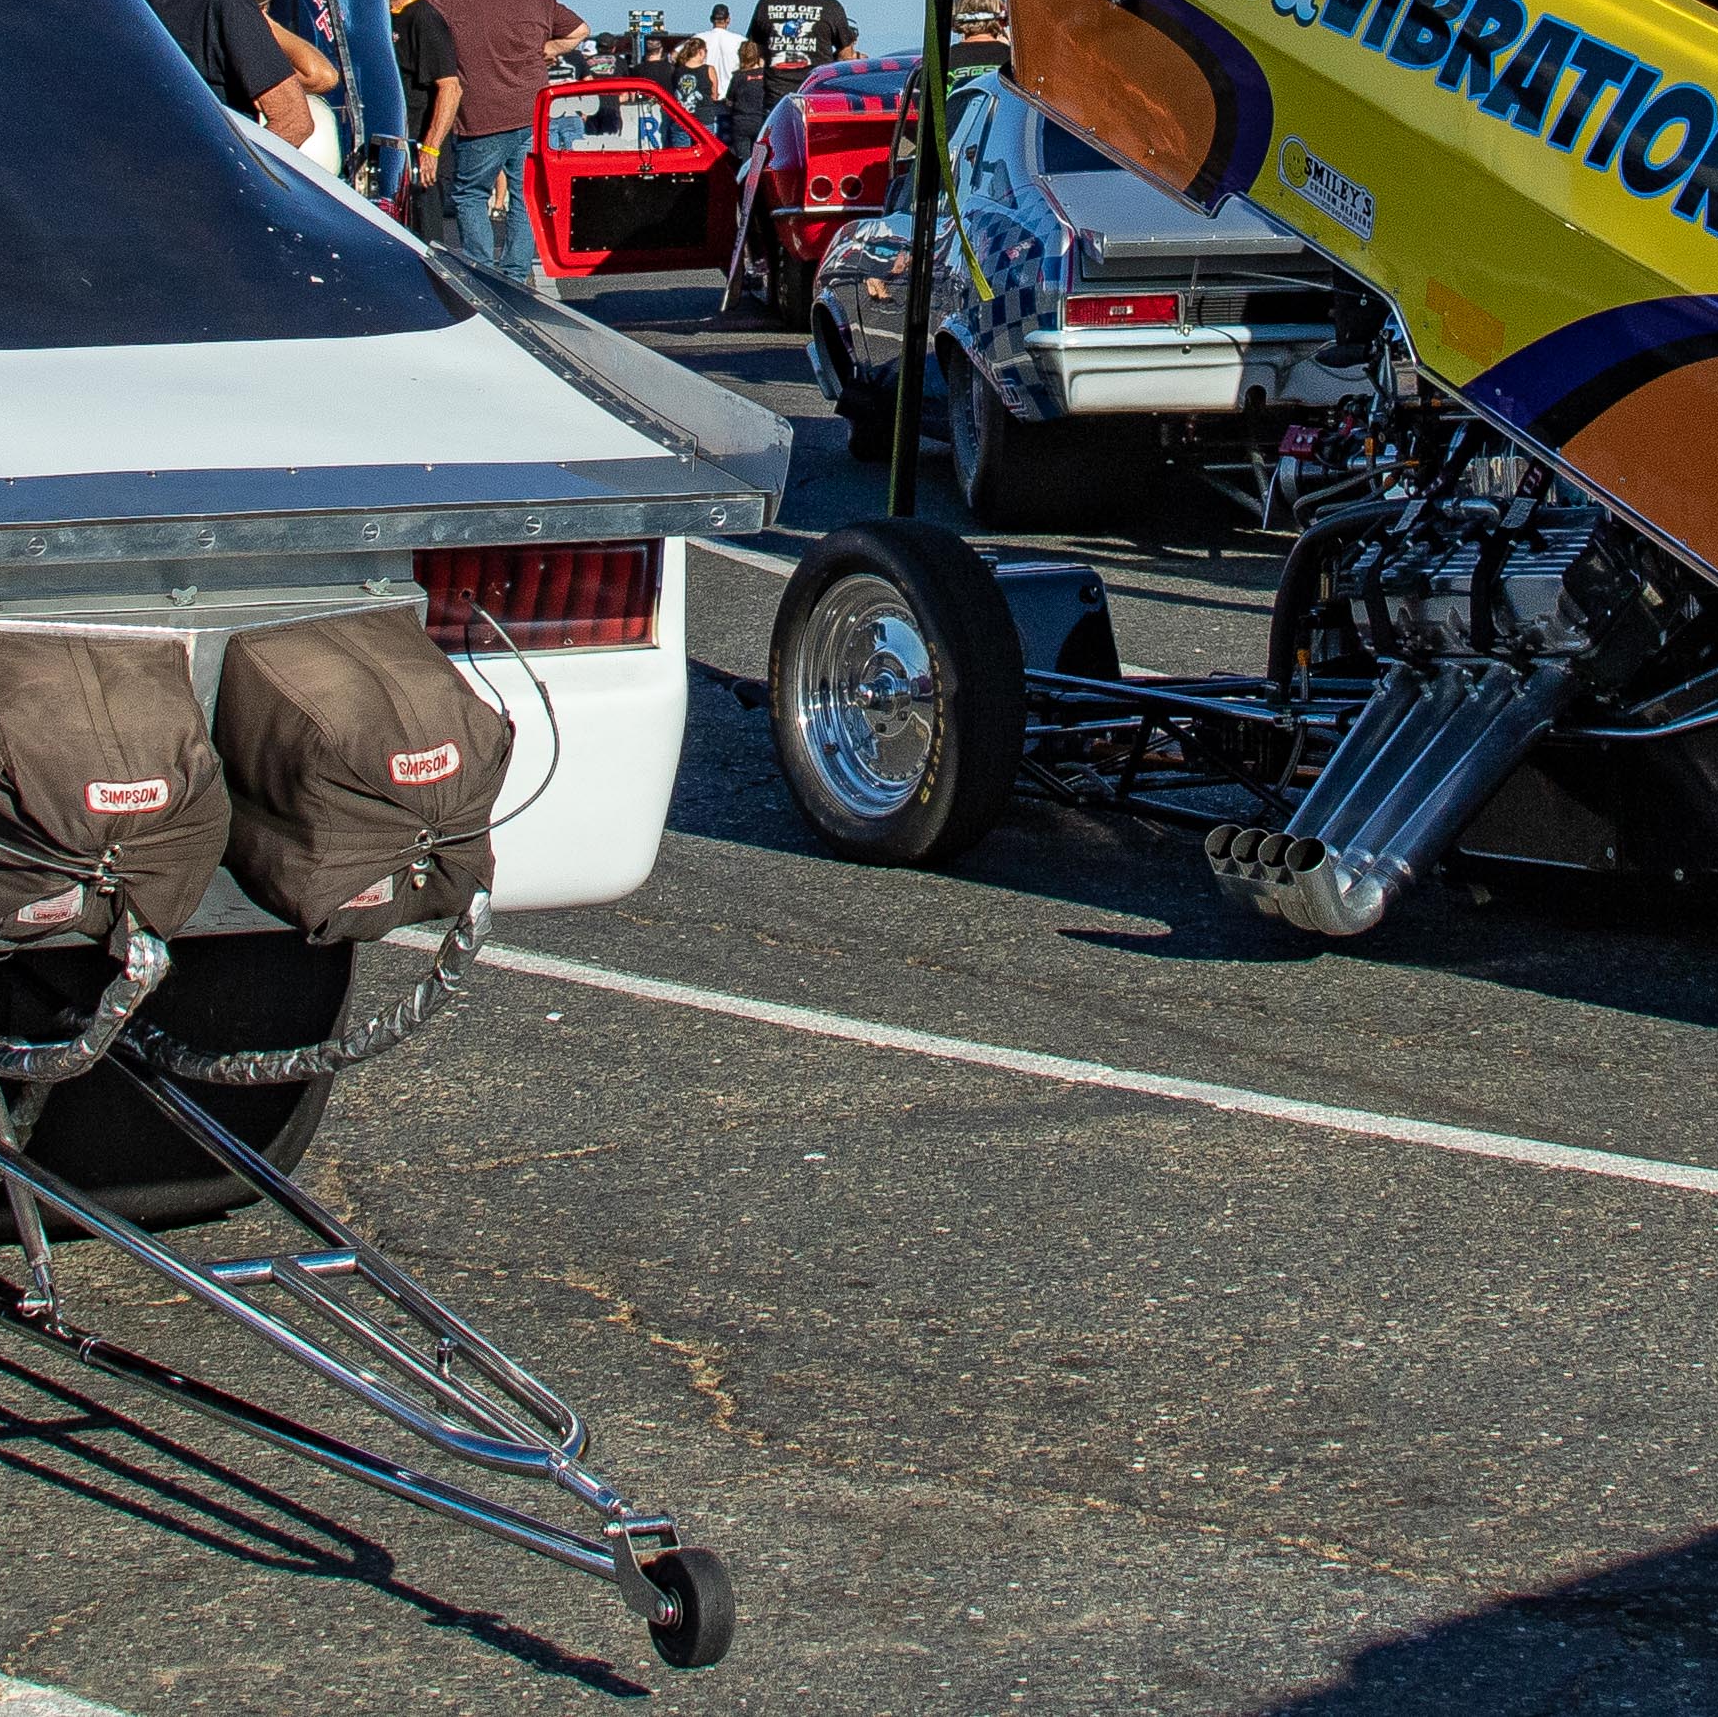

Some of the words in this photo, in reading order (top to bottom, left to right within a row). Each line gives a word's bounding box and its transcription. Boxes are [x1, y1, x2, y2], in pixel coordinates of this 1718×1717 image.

[768, 4, 795, 13] BOYS
[798, 5, 823, 14] GET
[768, 12, 785, 20] THE
[787, 12, 822, 21] BOTTLE
[795, 37, 817, 45] MEN
[1304, 157, 1372, 217] SMILEY'S
[398, 753, 448, 777] SIMPSON
[99, 787, 159, 805] SIMPSON
